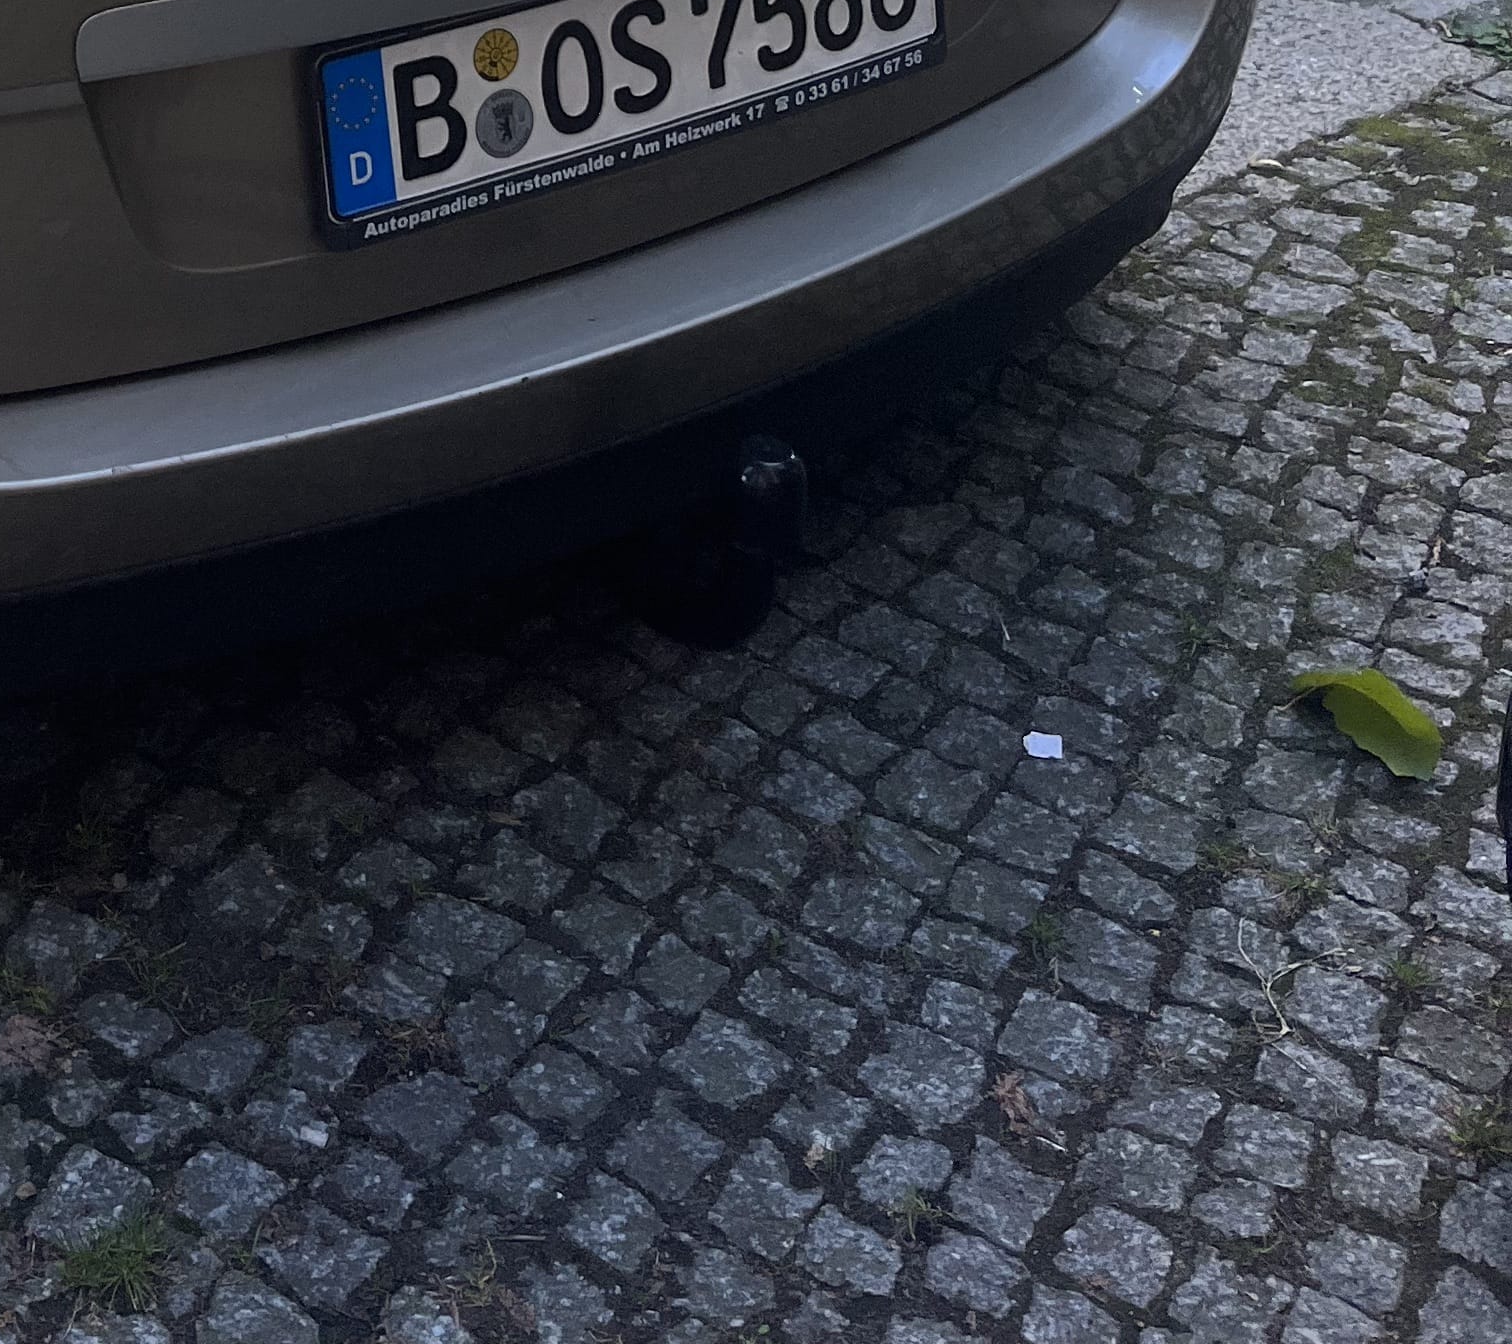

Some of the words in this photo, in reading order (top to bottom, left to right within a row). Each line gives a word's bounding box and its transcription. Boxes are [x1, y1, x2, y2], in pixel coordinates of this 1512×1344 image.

[349, 151, 373, 186] D
[364, 191, 488, 239] Autoparadies
[494, 152, 615, 201] Fürstenwalde
[632, 138, 661, 160] Am
[665, 113, 742, 149] Heizwerk
[746, 103, 766, 121] 17
[809, 82, 828, 102] 33
[831, 75, 849, 94] 61
[862, 65, 881, 83] 34
[884, 57, 902, 75] 67
[906, 49, 923, 68] 56
[393, 55, 468, 181] B
